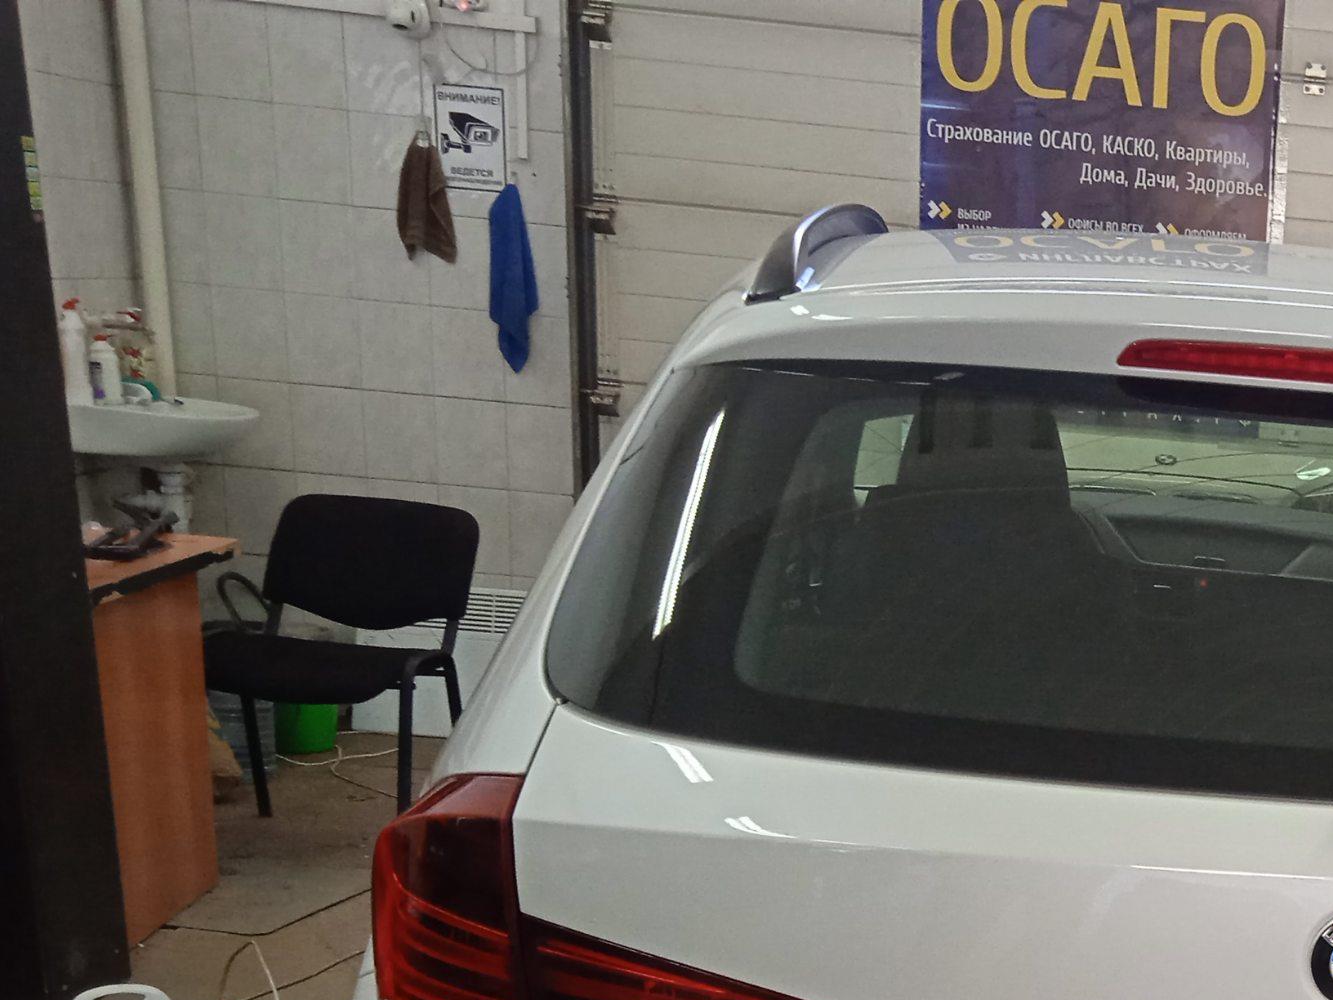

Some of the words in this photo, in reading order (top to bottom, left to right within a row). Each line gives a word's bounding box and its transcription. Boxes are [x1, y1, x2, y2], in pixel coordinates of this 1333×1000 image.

[936, 0, 1267, 117] ОСАГО
[926, 118, 1033, 148] Страхование
[1039, 129, 1096, 155] ОСАГО,
[1103, 135, 1159, 161] КАСКО,
[1165, 140, 1250, 169] Квартиры,
[1080, 163, 1128, 187] Дома,
[1134, 167, 1180, 192] Дачи,
[1185, 172, 1269, 199] Здоровье.
[957, 207, 992, 222] ВЫБОР
[1068, 217, 1101, 231] ОФИСЫ
